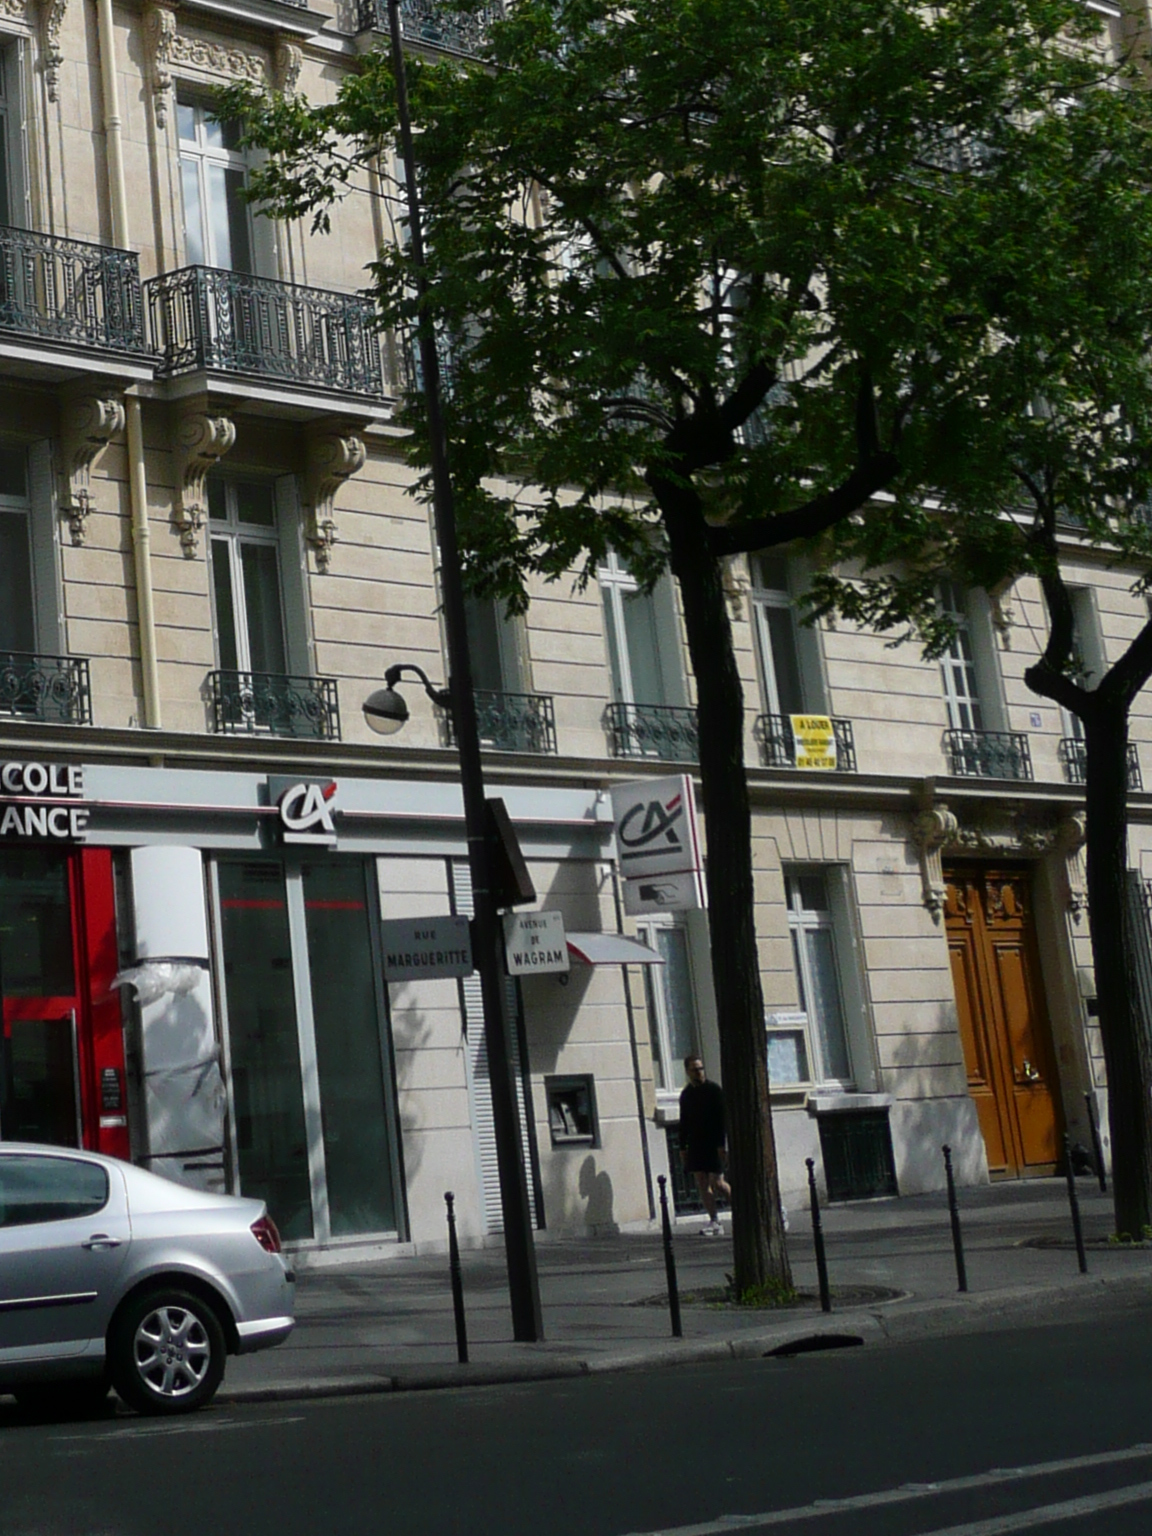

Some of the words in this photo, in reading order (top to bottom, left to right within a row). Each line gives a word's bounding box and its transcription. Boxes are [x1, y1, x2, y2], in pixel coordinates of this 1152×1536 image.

[807, 720, 829, 730] LOUER
[281, 782, 337, 831] CA
[619, 794, 683, 847] CA
[519, 919, 547, 929] AVENUE
[414, 930, 437, 940] RUE
[530, 935, 540, 945] DE
[387, 949, 469, 968] MARGUERITTE
[513, 950, 563, 967] WAGRAM
